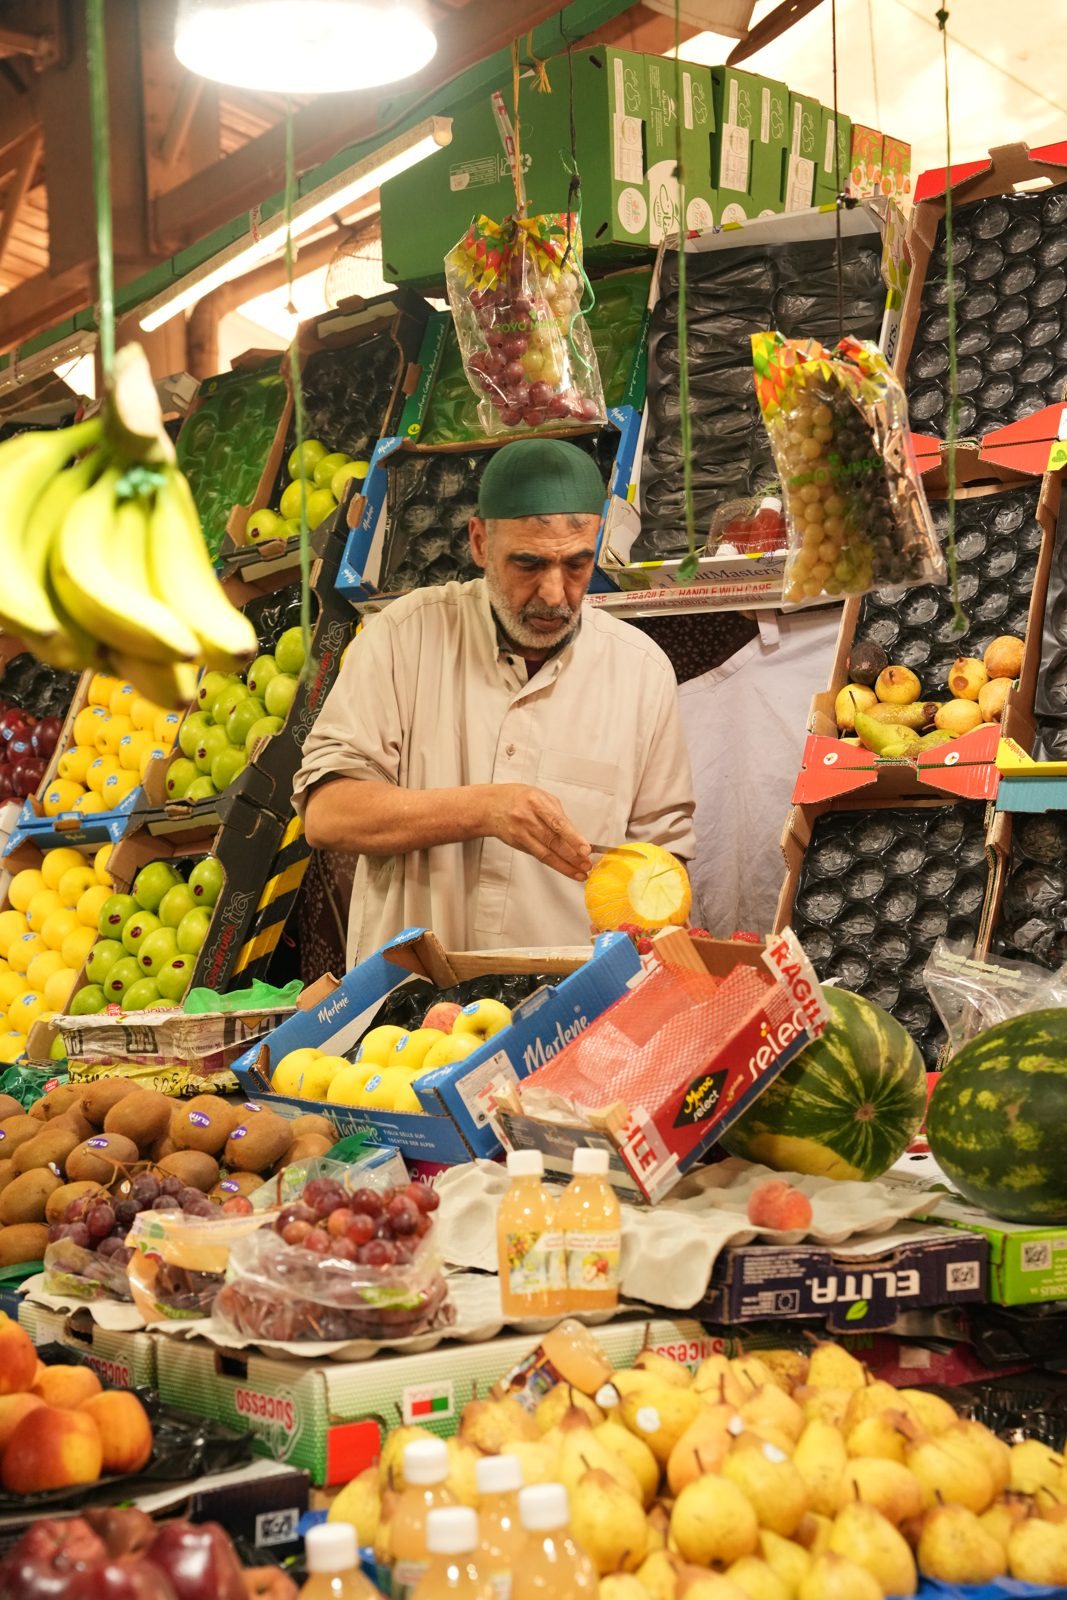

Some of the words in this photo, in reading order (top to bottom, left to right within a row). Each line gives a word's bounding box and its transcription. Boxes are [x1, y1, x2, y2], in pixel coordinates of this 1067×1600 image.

[666, 565, 785, 583] FuitMasters.
[769, 939, 828, 1037] RAGILE
[317, 995, 350, 1025] Marlene
[522, 1014, 590, 1075] Marlene
[748, 1007, 806, 1083] selec
[693, 1089, 720, 1123] select
[623, 1118, 657, 1172] ILE
[810, 1269, 920, 1304] ELITA
[235, 1389, 294, 1431] Sucesso
